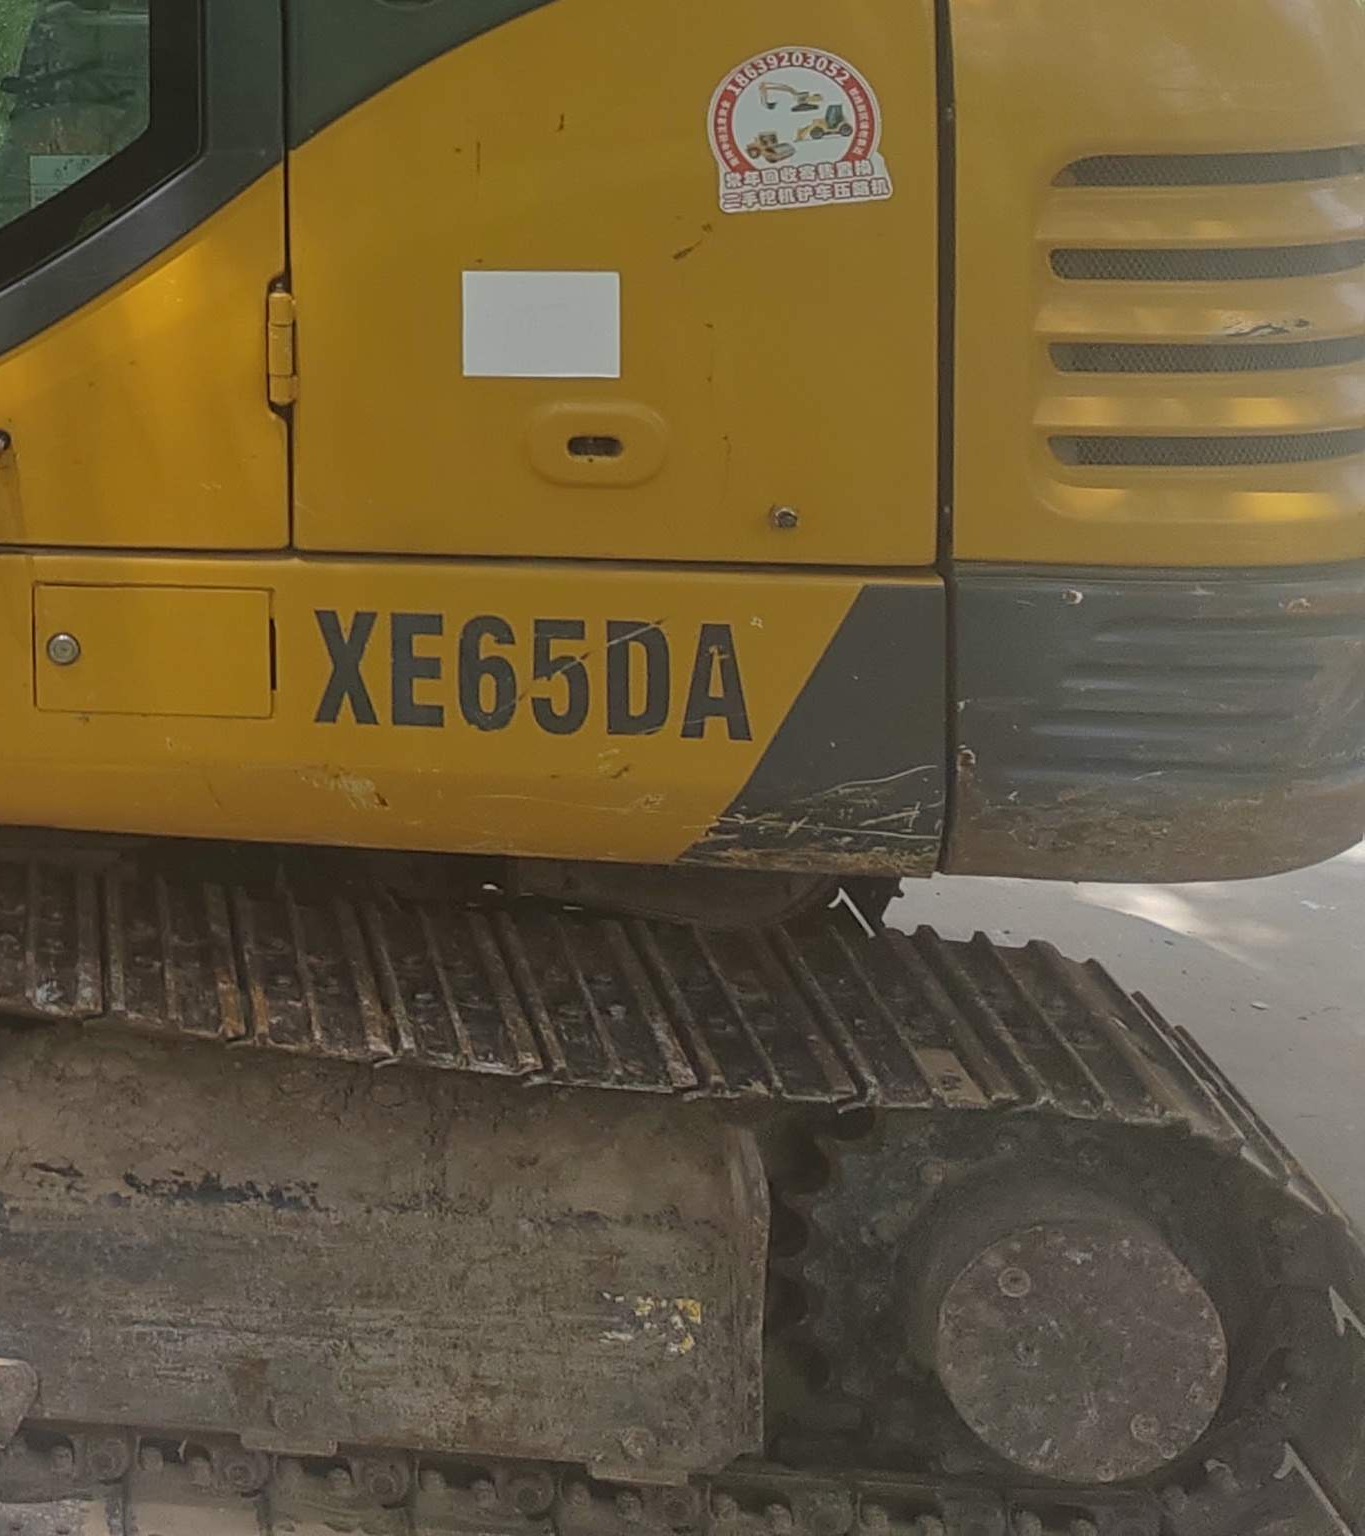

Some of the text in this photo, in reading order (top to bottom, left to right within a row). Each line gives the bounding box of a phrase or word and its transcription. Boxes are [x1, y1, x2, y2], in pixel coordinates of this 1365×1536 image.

[727, 52, 851, 96] 18639203052
[722, 178, 890, 209] 二手挖机铲车压路机
[313, 608, 754, 742] XE65DA
